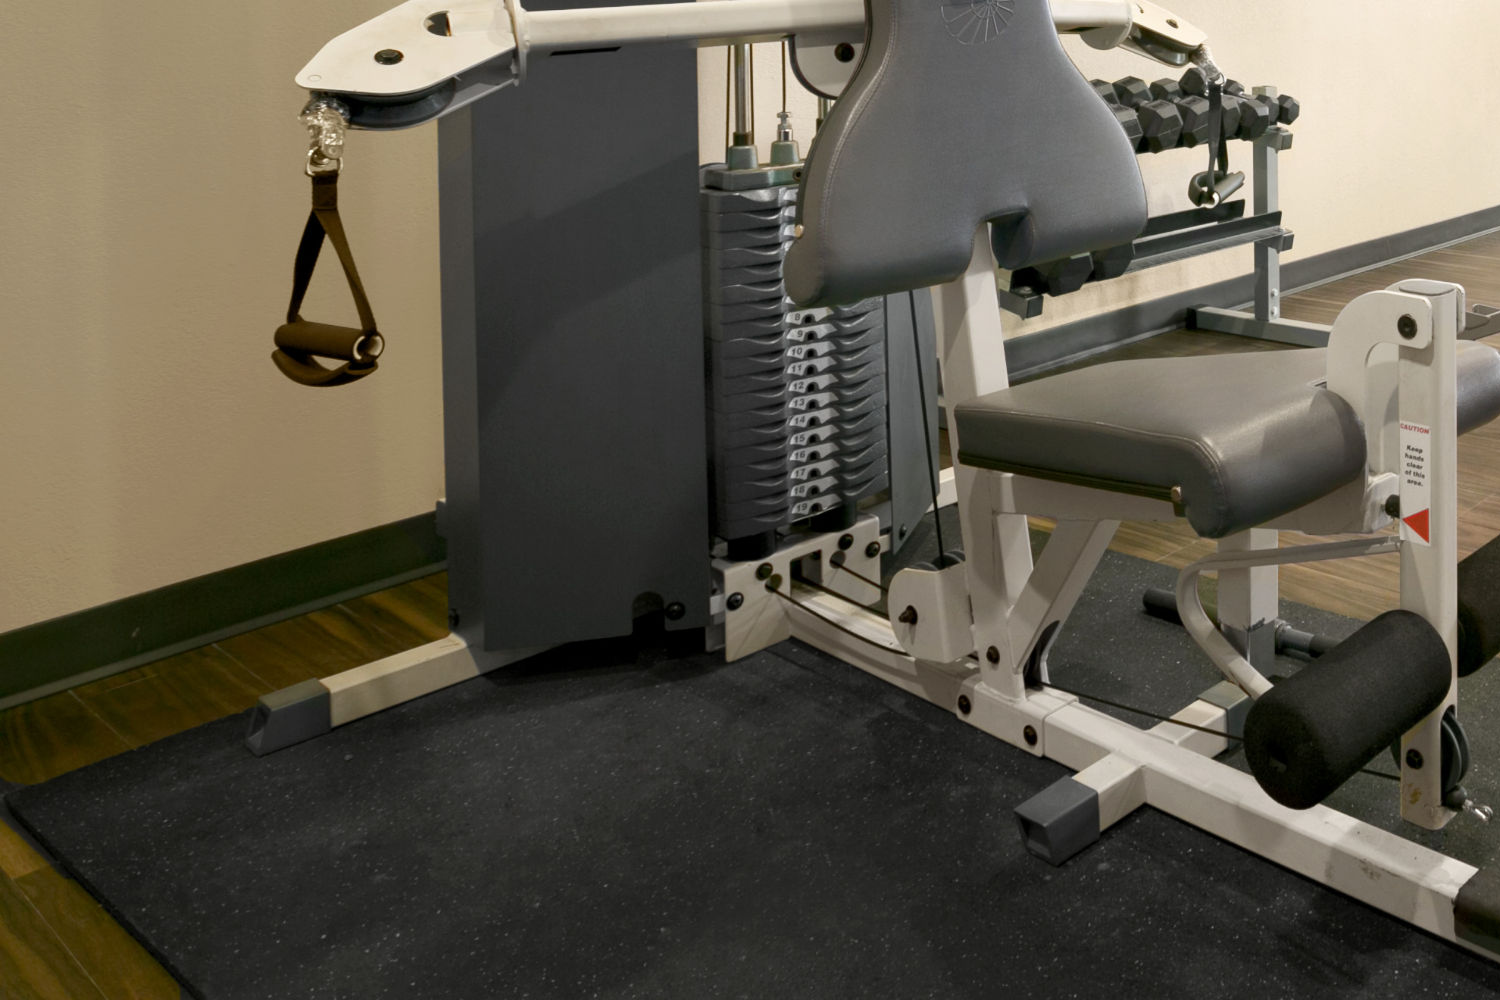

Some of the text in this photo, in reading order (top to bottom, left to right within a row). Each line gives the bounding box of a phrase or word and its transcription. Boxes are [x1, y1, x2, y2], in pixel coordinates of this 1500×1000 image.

[795, 312, 801, 321] 8
[797, 329, 803, 338] 9
[792, 346, 803, 356] 10
[792, 364, 802, 373] 11
[794, 381, 805, 390] 12
[794, 398, 805, 407] 13
[795, 416, 806, 425] 14
[1400, 423, 1429, 434] CAUTION
[795, 433, 805, 442] 15
[1407, 444, 1423, 454] Keep
[795, 450, 806, 459] 16
[1404, 452, 1425, 462] hands
[1406, 462, 1423, 470] clear
[796, 467, 806, 477] 17
[1413, 471, 1425, 479] this
[1407, 479, 1424, 487] area.
[795, 485, 806, 494] 18
[797, 502, 808, 512] 19
